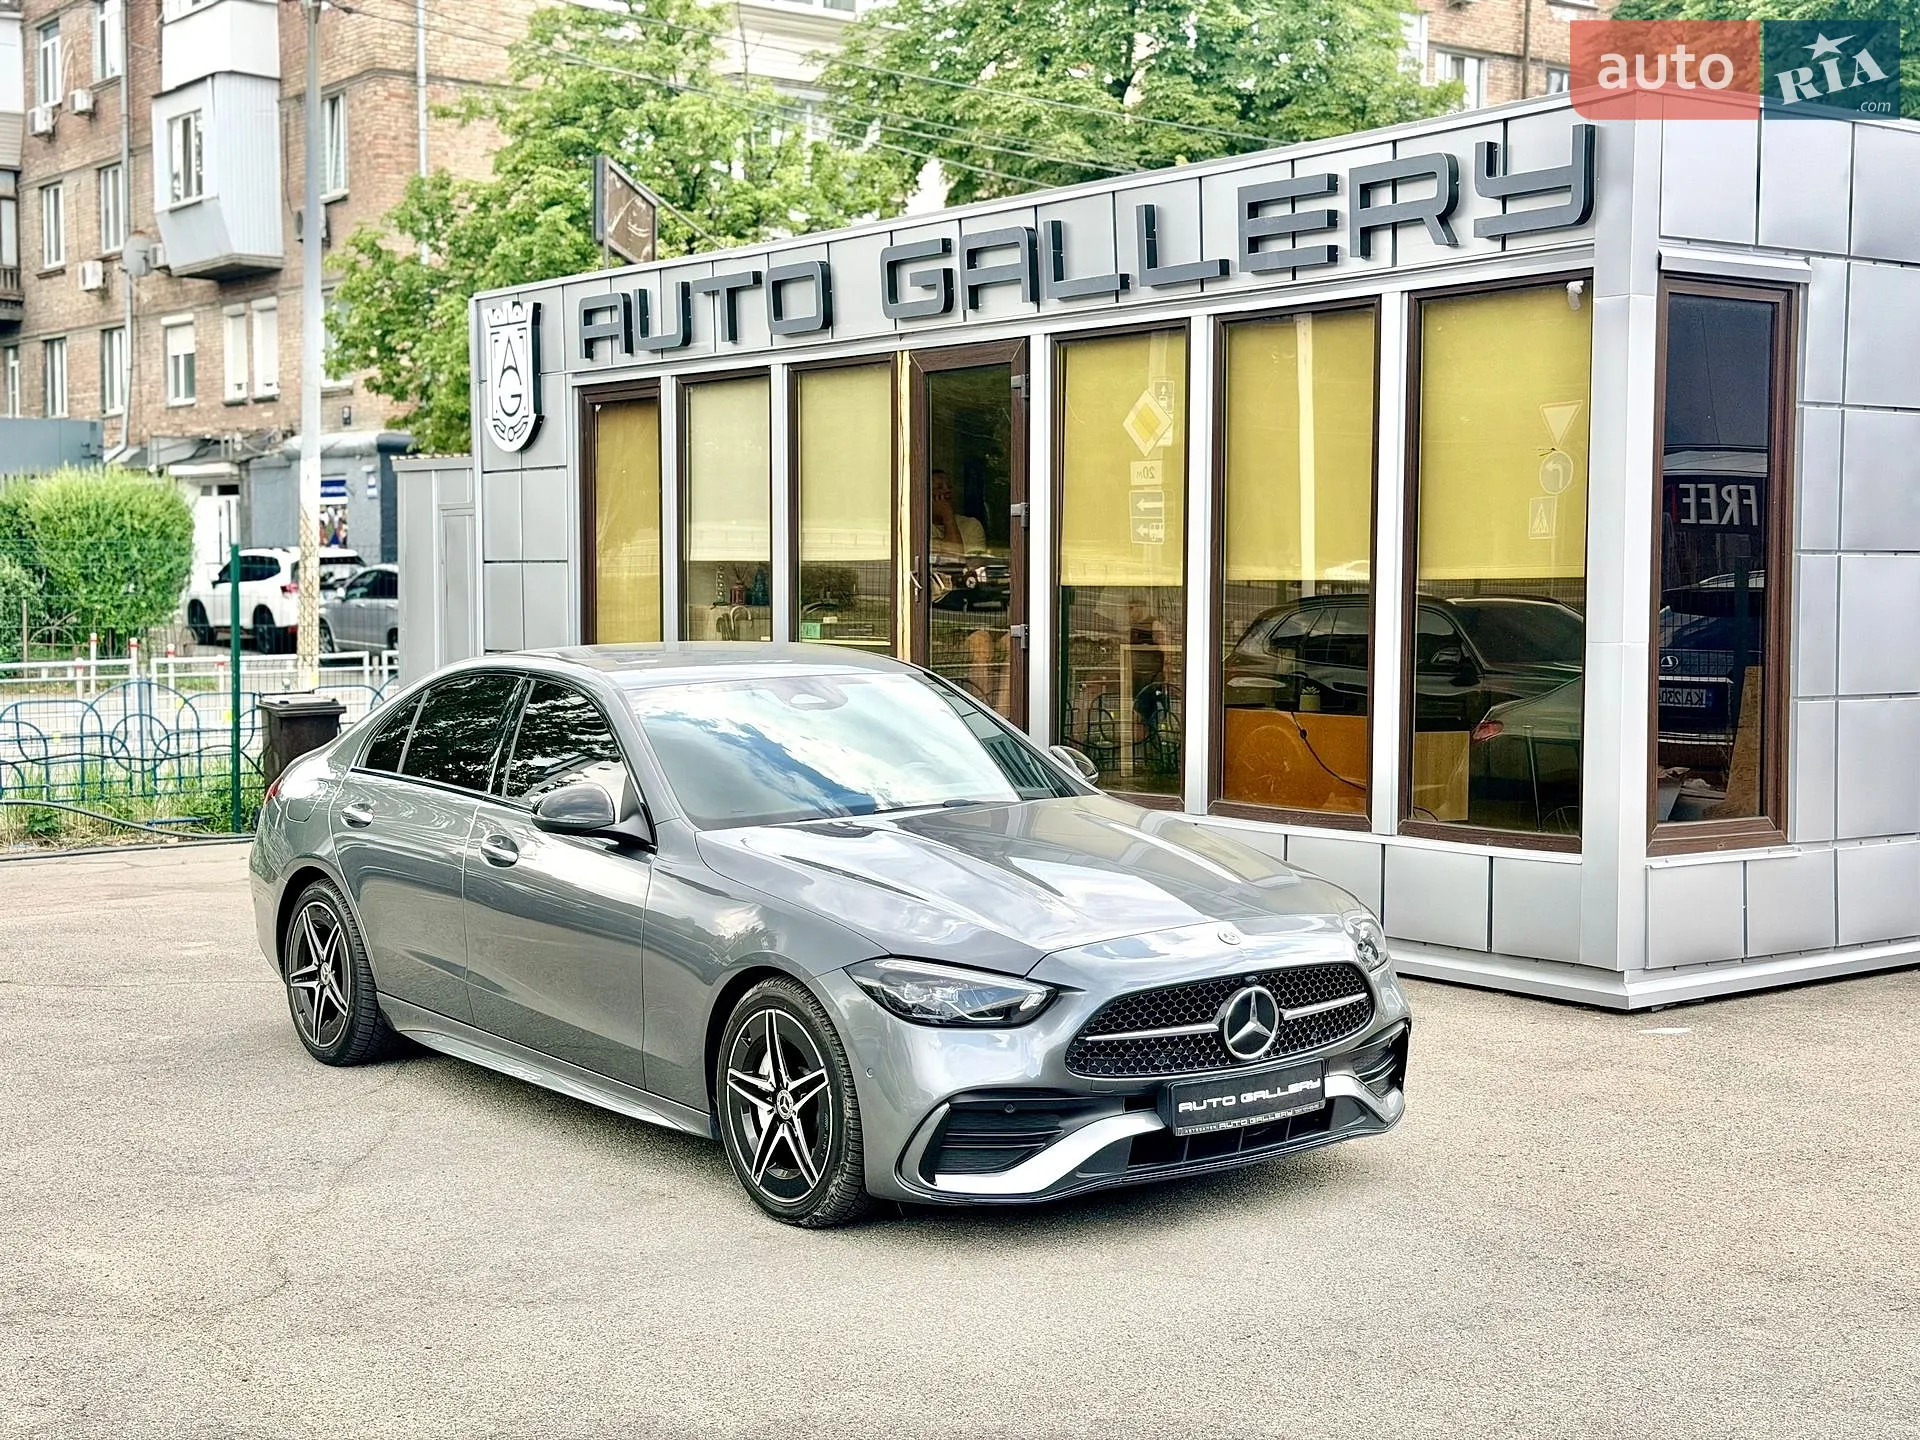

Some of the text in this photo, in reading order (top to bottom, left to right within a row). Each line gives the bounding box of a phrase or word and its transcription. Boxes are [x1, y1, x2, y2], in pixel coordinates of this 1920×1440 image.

[578, 124, 1596, 359] AUTO GALLERY
[1178, 1077, 1321, 1113] AUTO GALLERY
[1218, 1119, 1248, 1129] AUTO
[1249, 1109, 1293, 1124] GALLERY
